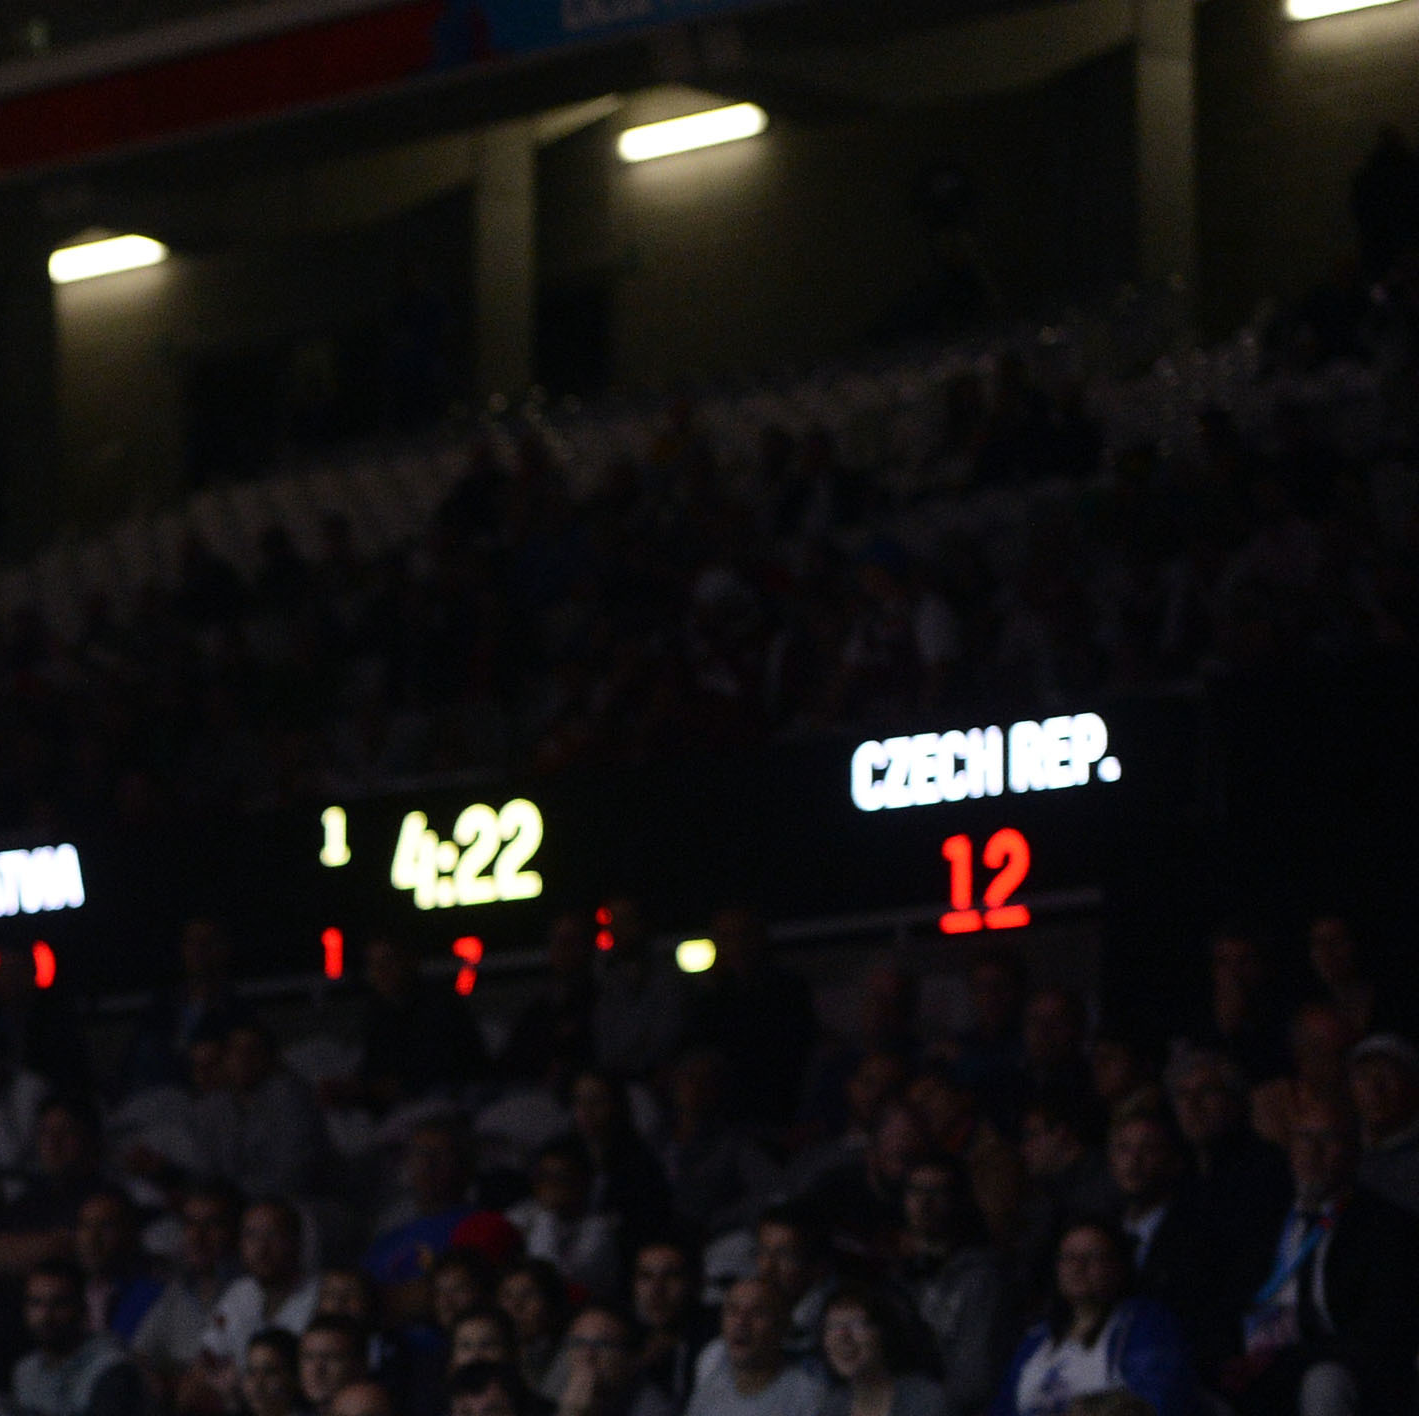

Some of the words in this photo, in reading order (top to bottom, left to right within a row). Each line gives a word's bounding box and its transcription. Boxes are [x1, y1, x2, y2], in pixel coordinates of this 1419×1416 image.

[851, 726, 1005, 811] CZECH
[1008, 712, 1122, 793] REP.
[391, 798, 544, 910] 4:22
[939, 827, 1031, 934] 12
